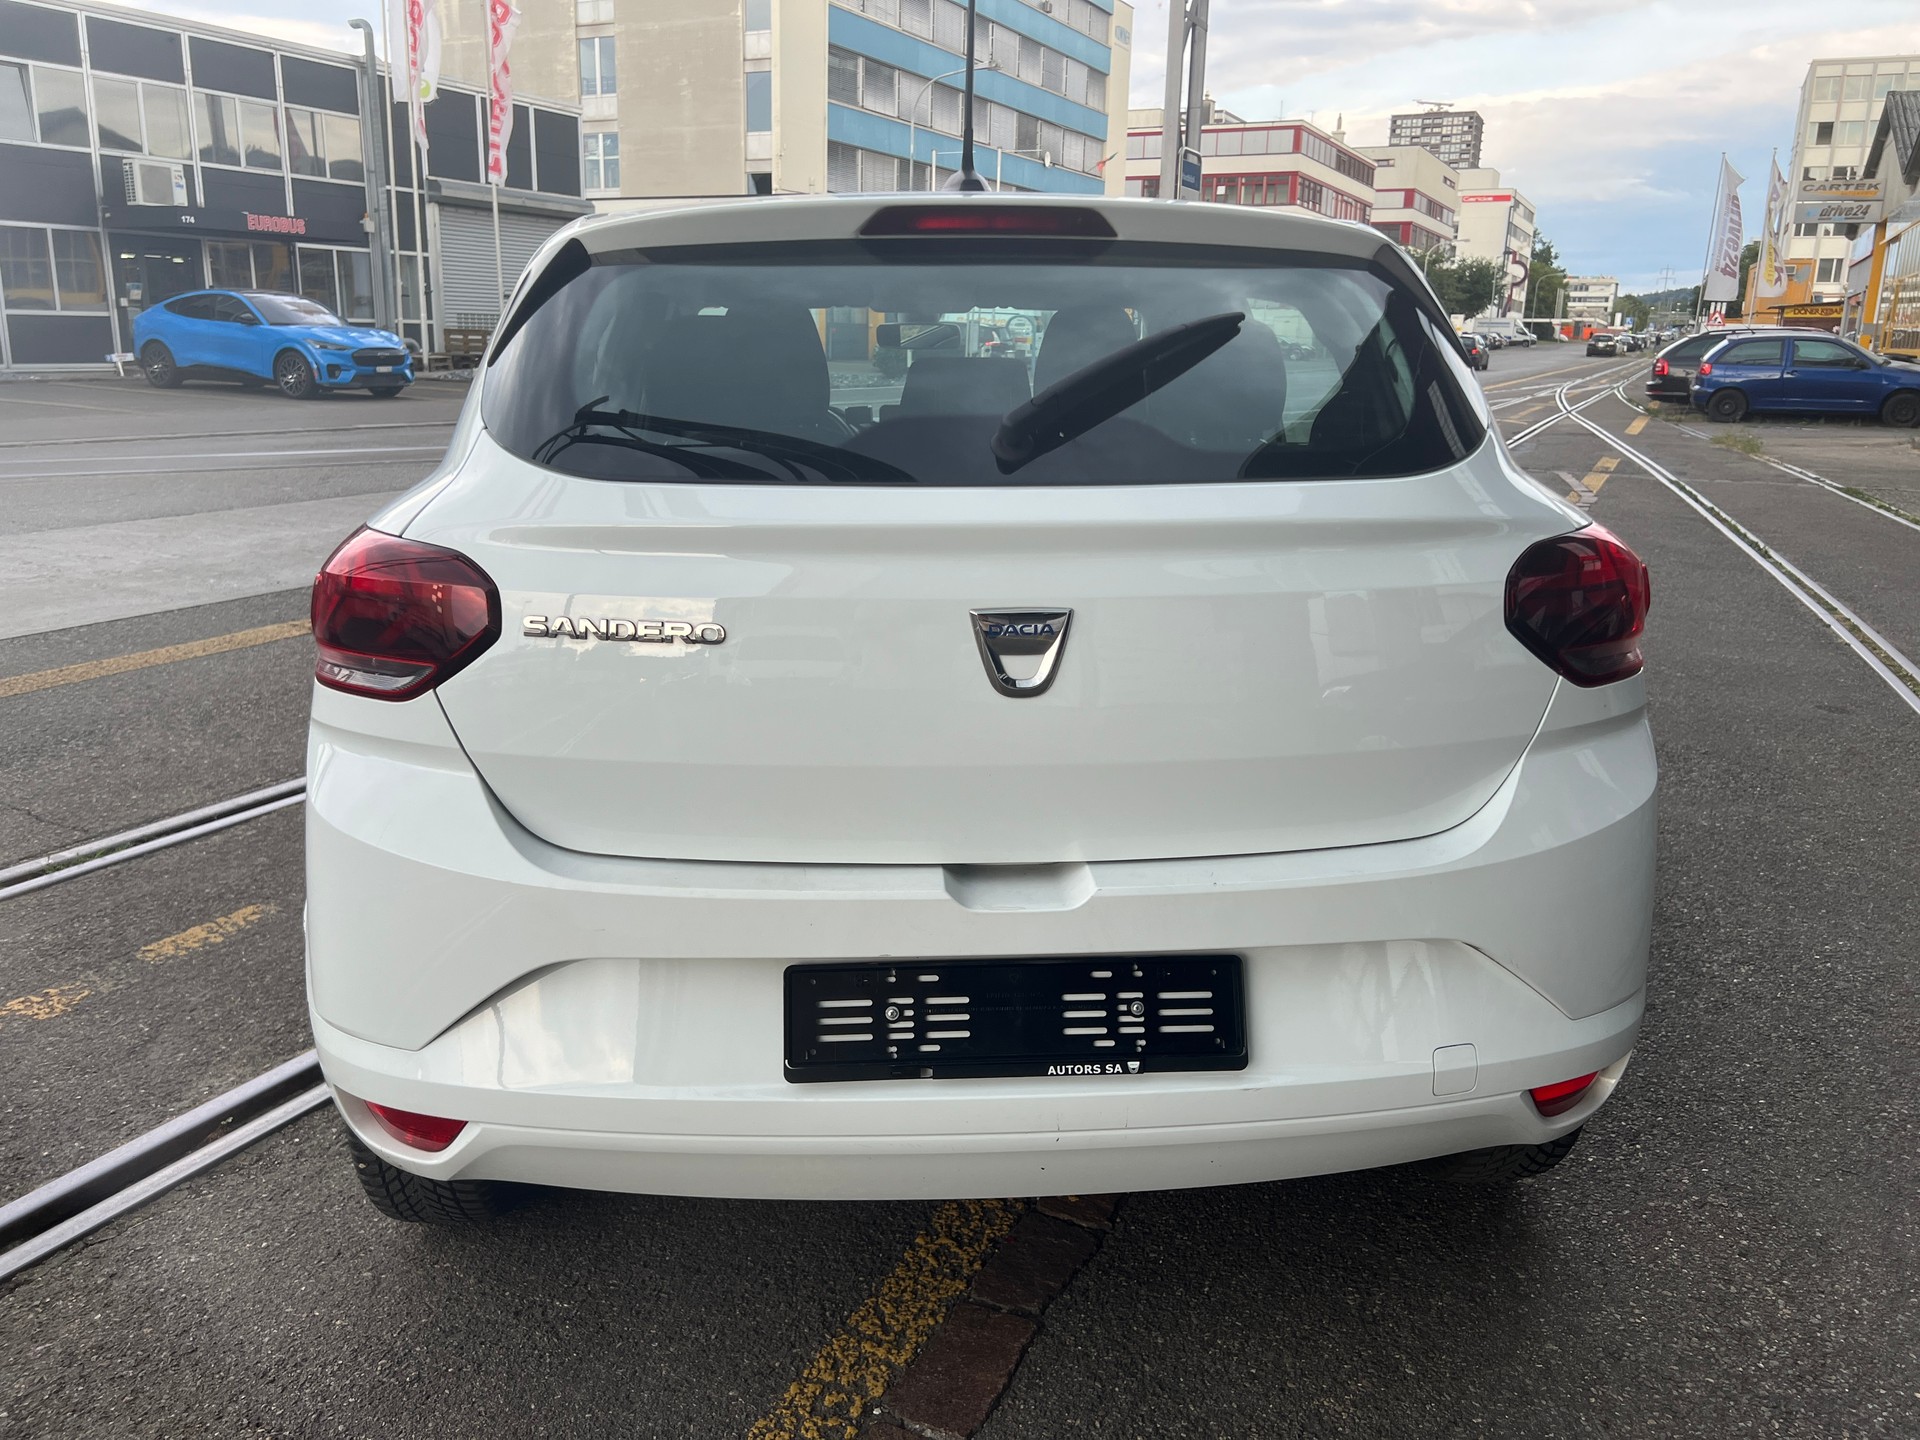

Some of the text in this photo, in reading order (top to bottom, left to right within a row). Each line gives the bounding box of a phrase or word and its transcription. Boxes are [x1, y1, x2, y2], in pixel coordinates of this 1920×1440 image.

[1802, 182, 1881, 192] CARTEK
[1819, 204, 1871, 217] drive24
[181, 215, 195, 224] 174
[248, 214, 306, 234] EUROBUS
[523, 615, 726, 645] SANDERO
[988, 624, 1055, 638] DACIA
[1047, 1064, 1101, 1075] AUTORS
[1105, 1063, 1123, 1074] SA
